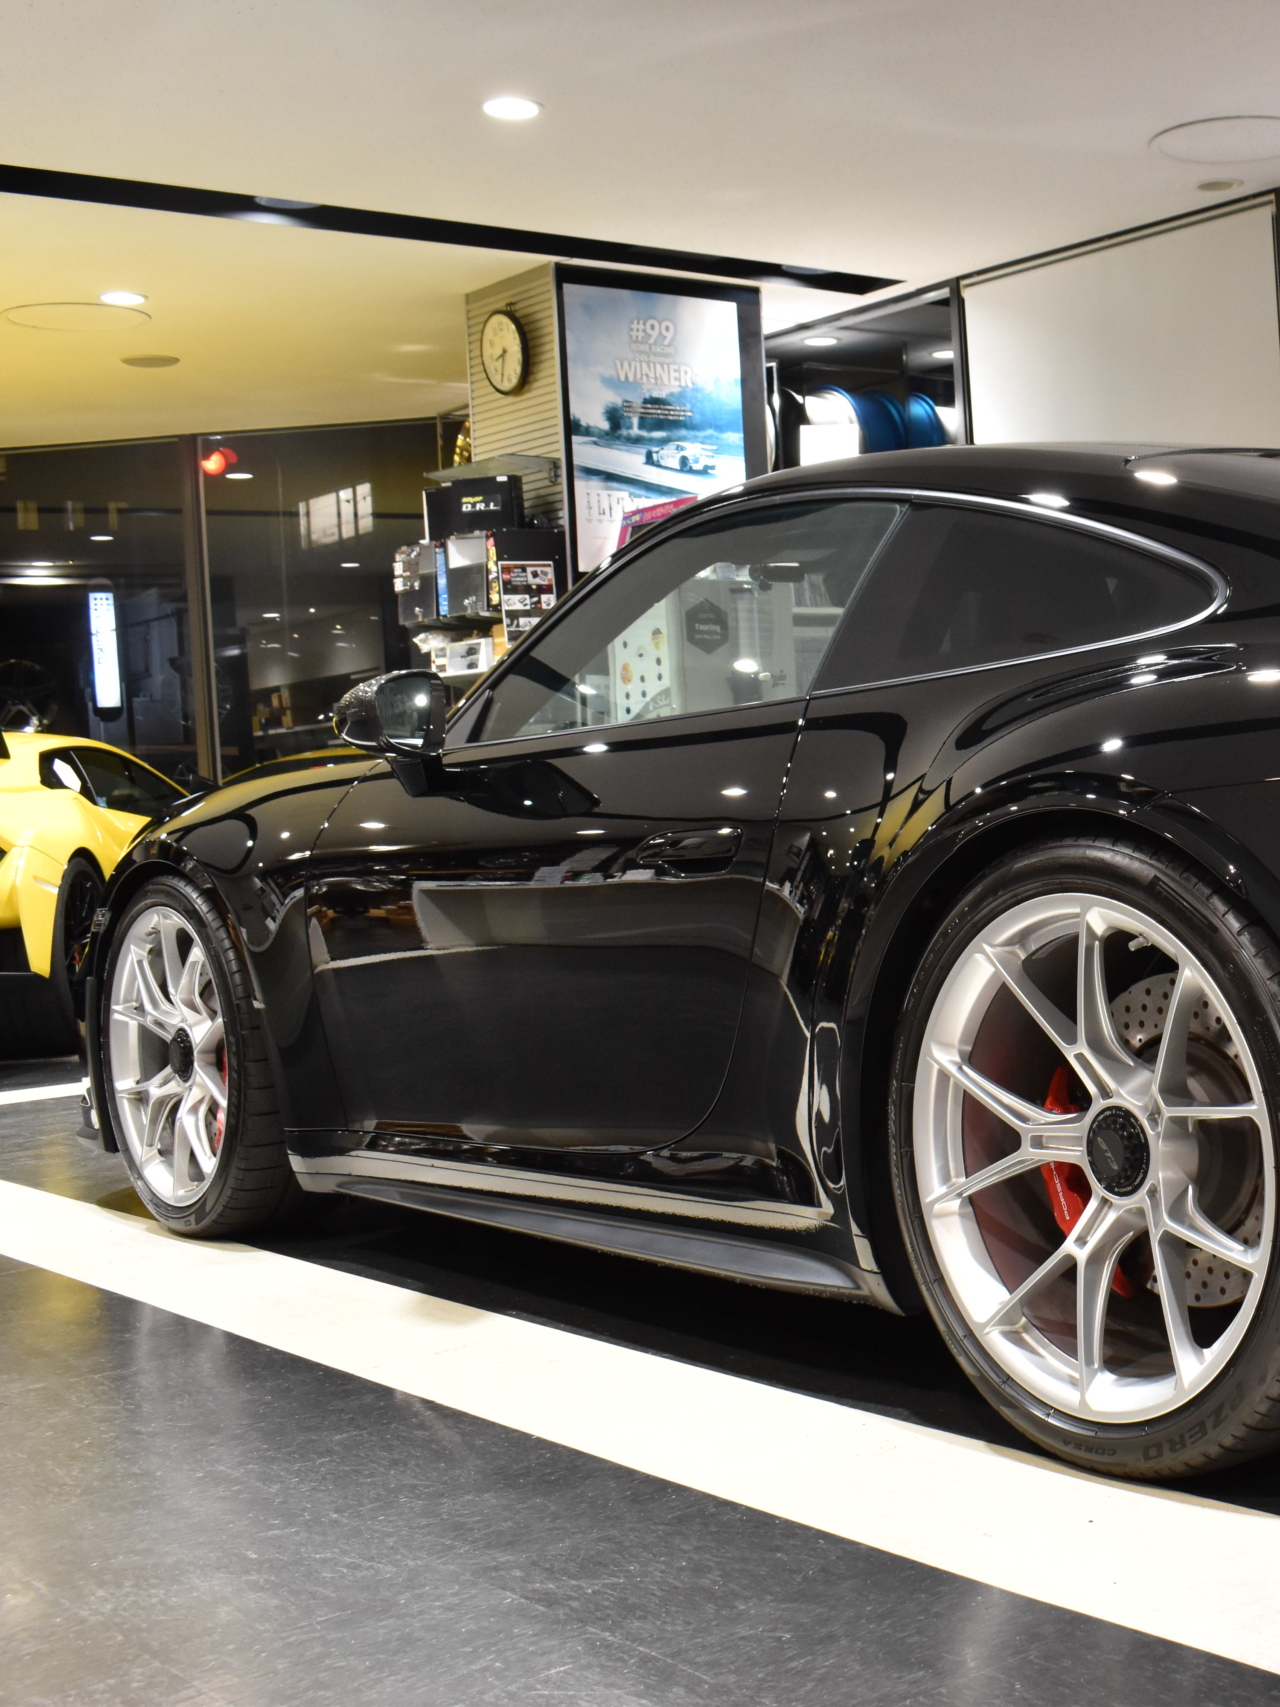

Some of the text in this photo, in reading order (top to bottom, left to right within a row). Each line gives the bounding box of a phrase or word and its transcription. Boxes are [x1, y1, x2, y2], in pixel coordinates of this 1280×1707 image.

[630, 318, 675, 345] #99
[615, 359, 693, 387] WINNER
[1061, 1438, 1117, 1457] CORSA
